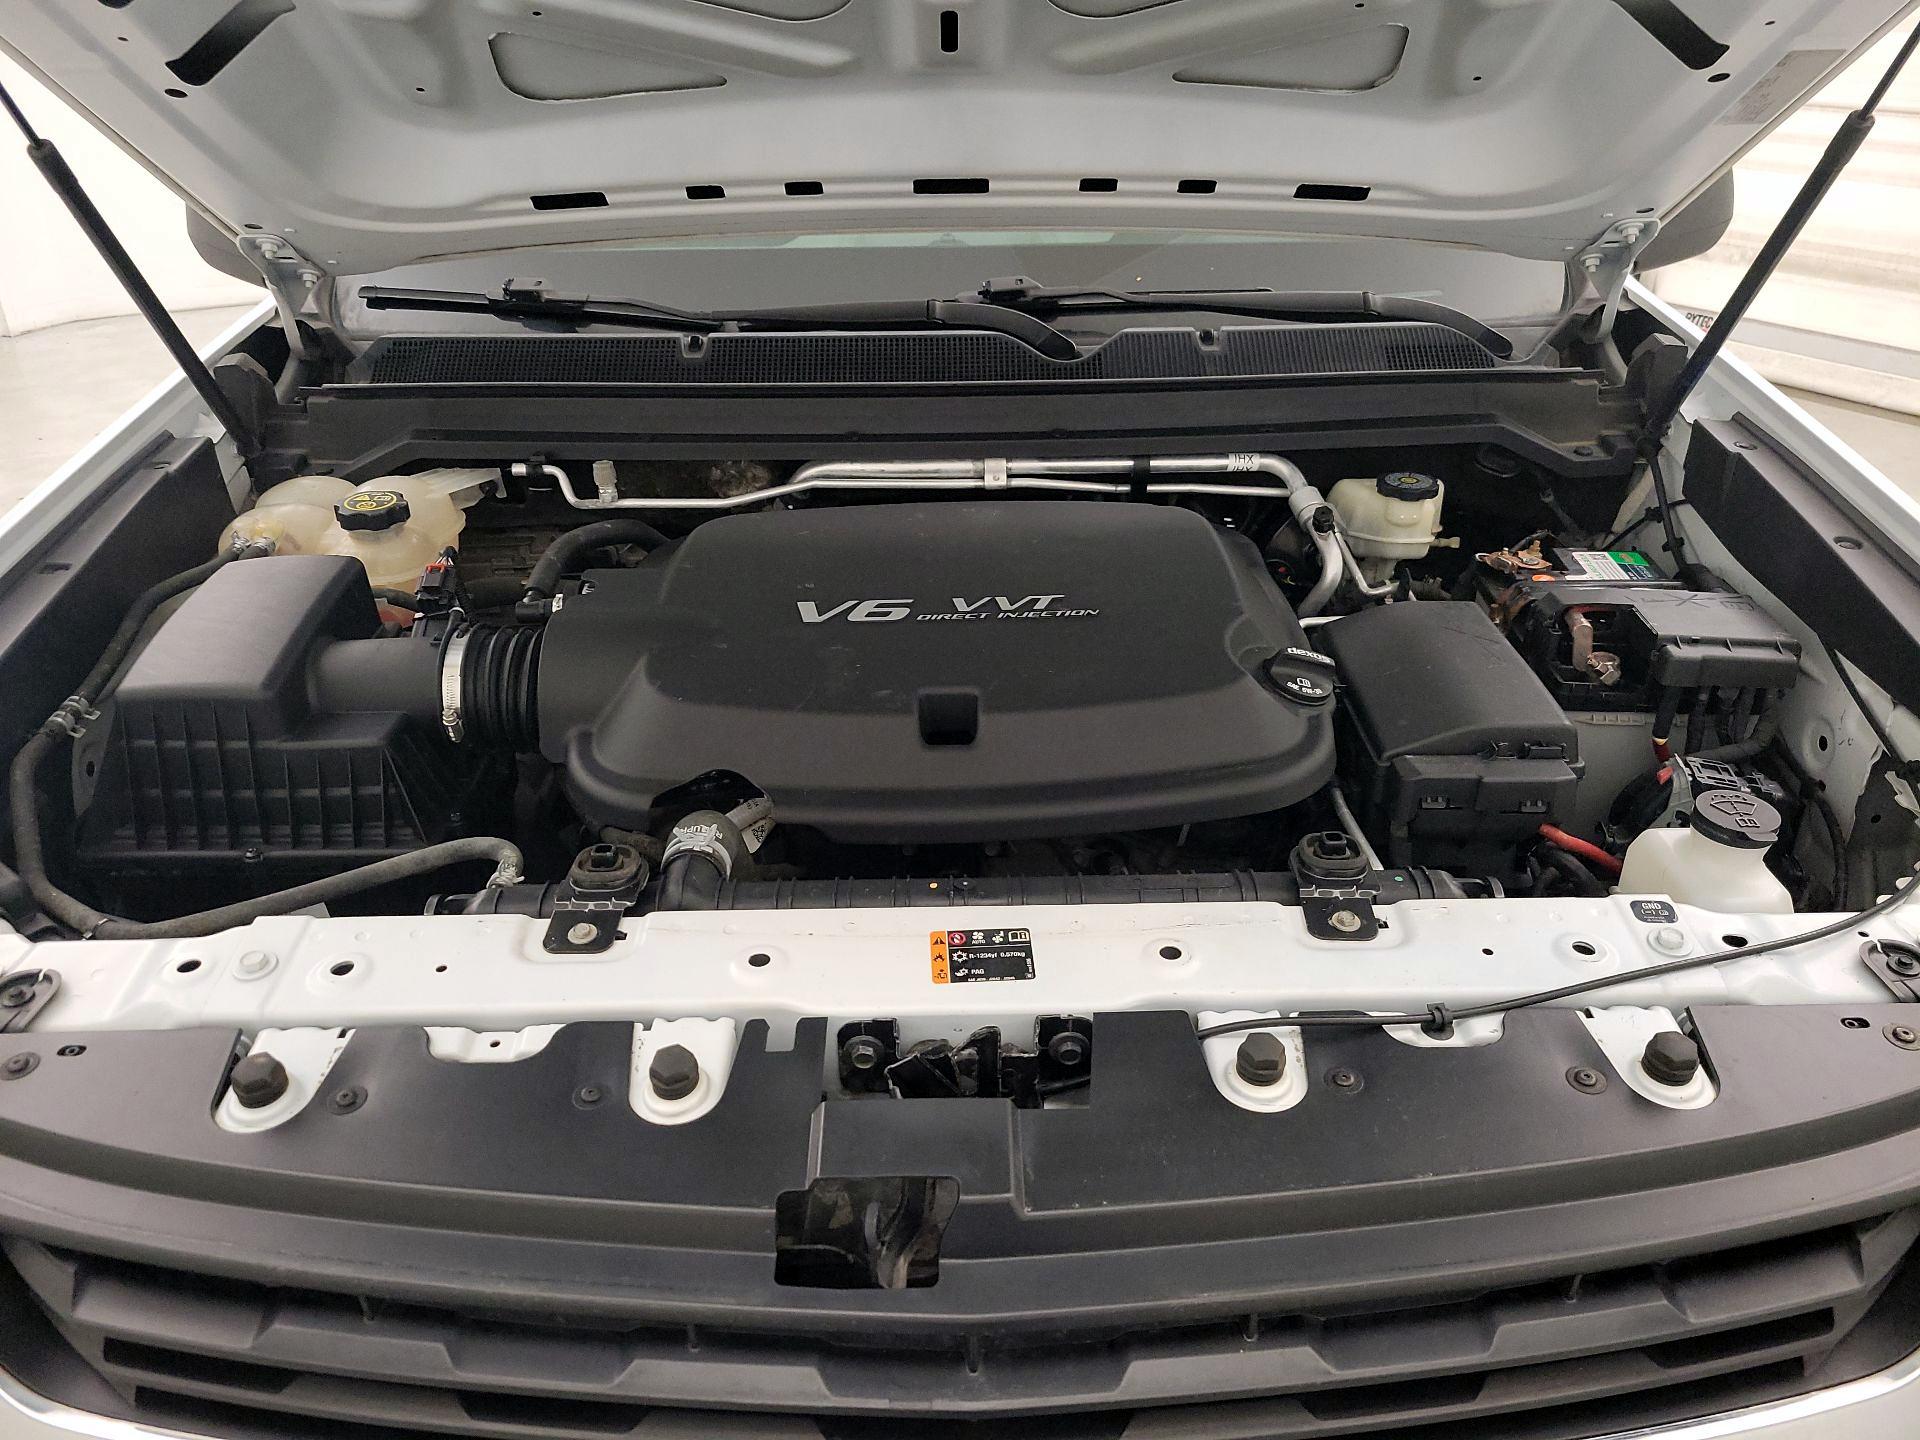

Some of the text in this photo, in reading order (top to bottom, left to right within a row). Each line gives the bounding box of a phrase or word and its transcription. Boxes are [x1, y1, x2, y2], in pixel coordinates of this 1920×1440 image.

[952, 594, 1065, 612] VVT
[797, 599, 915, 623] V6
[916, 609, 1100, 621] DIRECT INJECTION
[1641, 902, 1661, 910] GND
